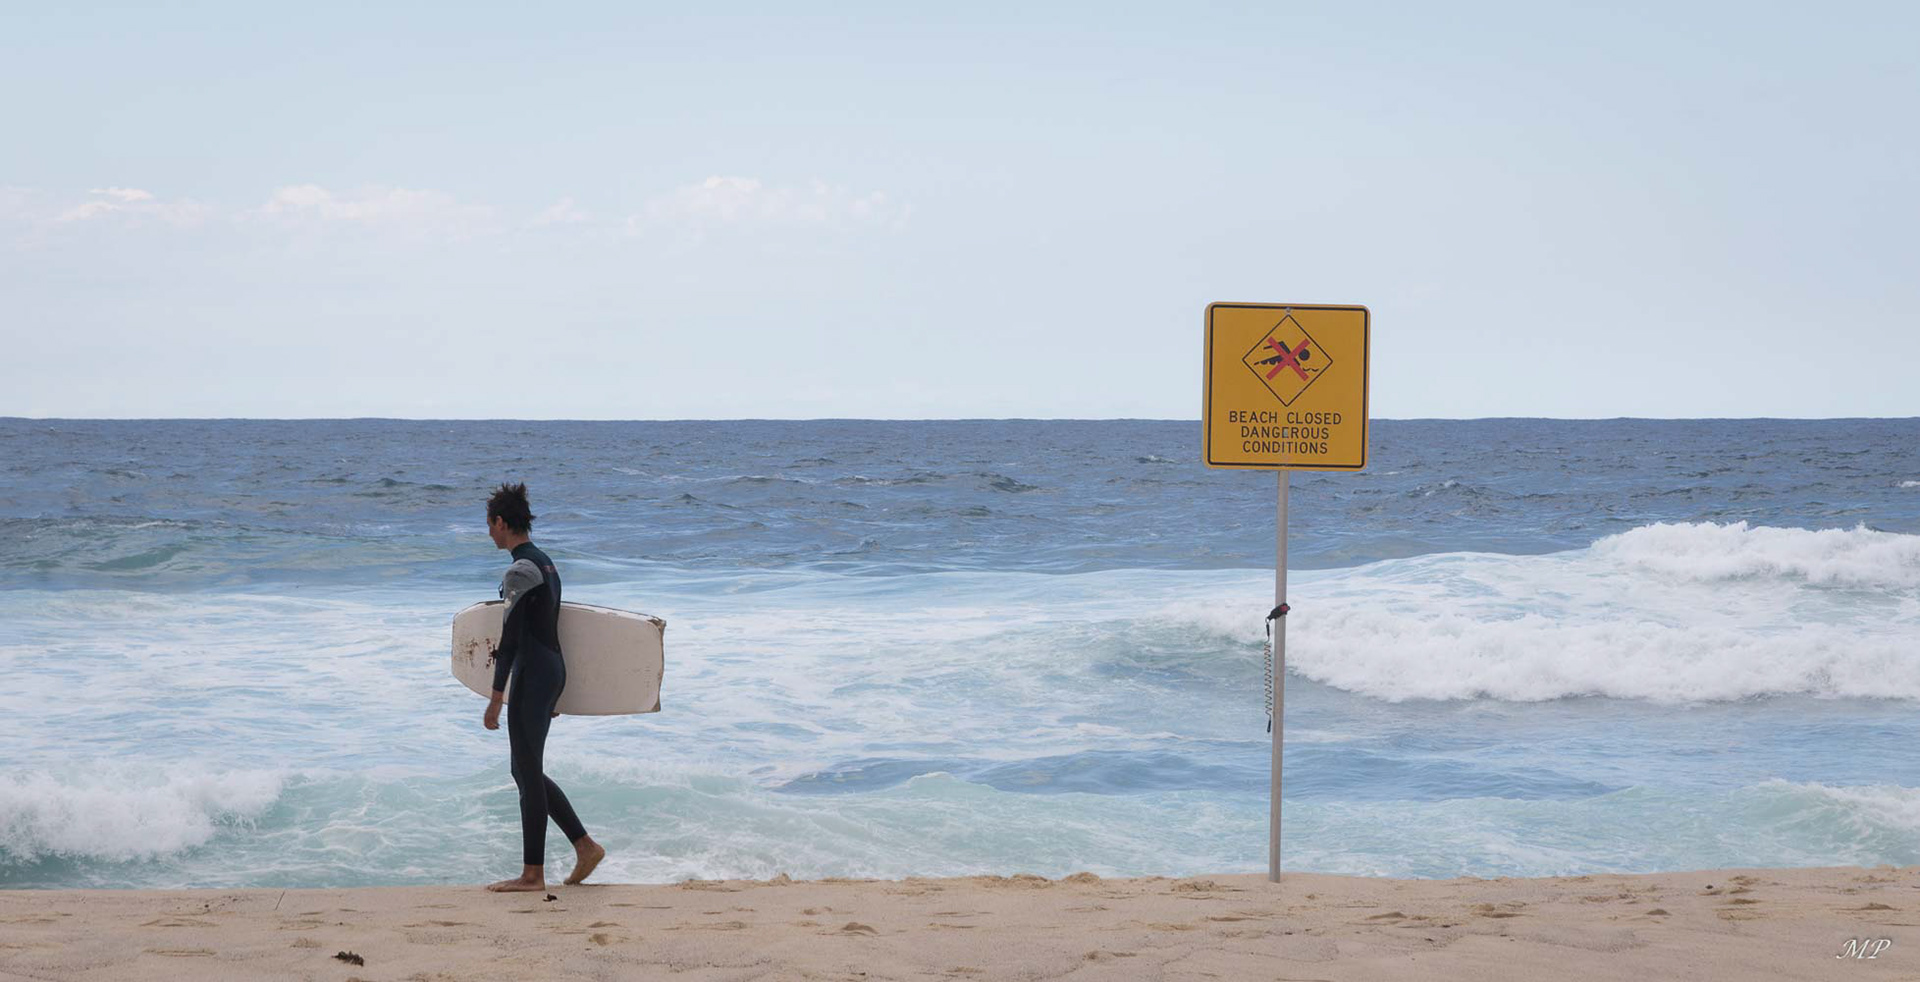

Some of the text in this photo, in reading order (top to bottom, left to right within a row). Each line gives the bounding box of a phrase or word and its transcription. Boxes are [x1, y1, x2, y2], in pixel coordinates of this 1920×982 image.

[1229, 411, 1341, 424] BEACH CLOSED
[1241, 426, 1329, 439] DANGEROUS
[1242, 441, 1328, 454] CONDITIONS
